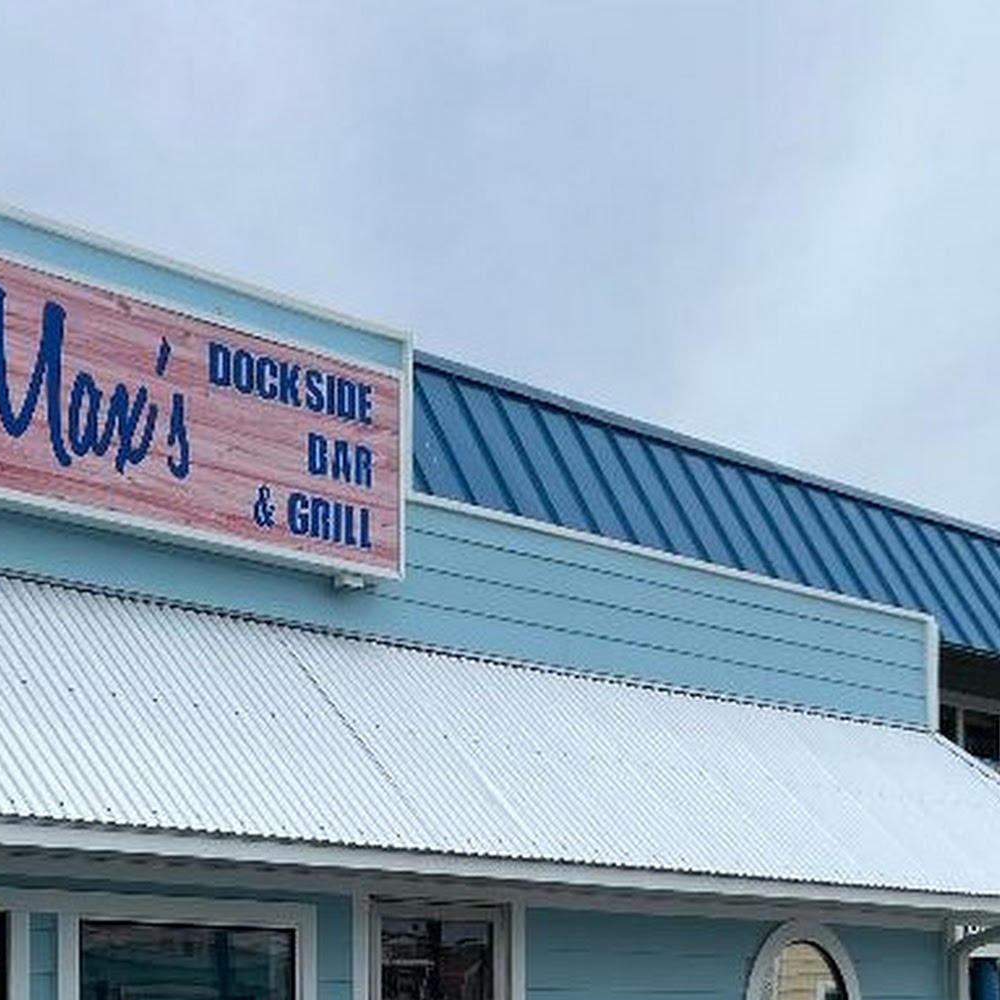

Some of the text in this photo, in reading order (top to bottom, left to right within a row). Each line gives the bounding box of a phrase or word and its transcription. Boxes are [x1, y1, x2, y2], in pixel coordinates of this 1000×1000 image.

[208, 341, 373, 425] DOCKSIDE
[307, 431, 374, 488] BAR
[253, 484, 373, 549] & GRILL
